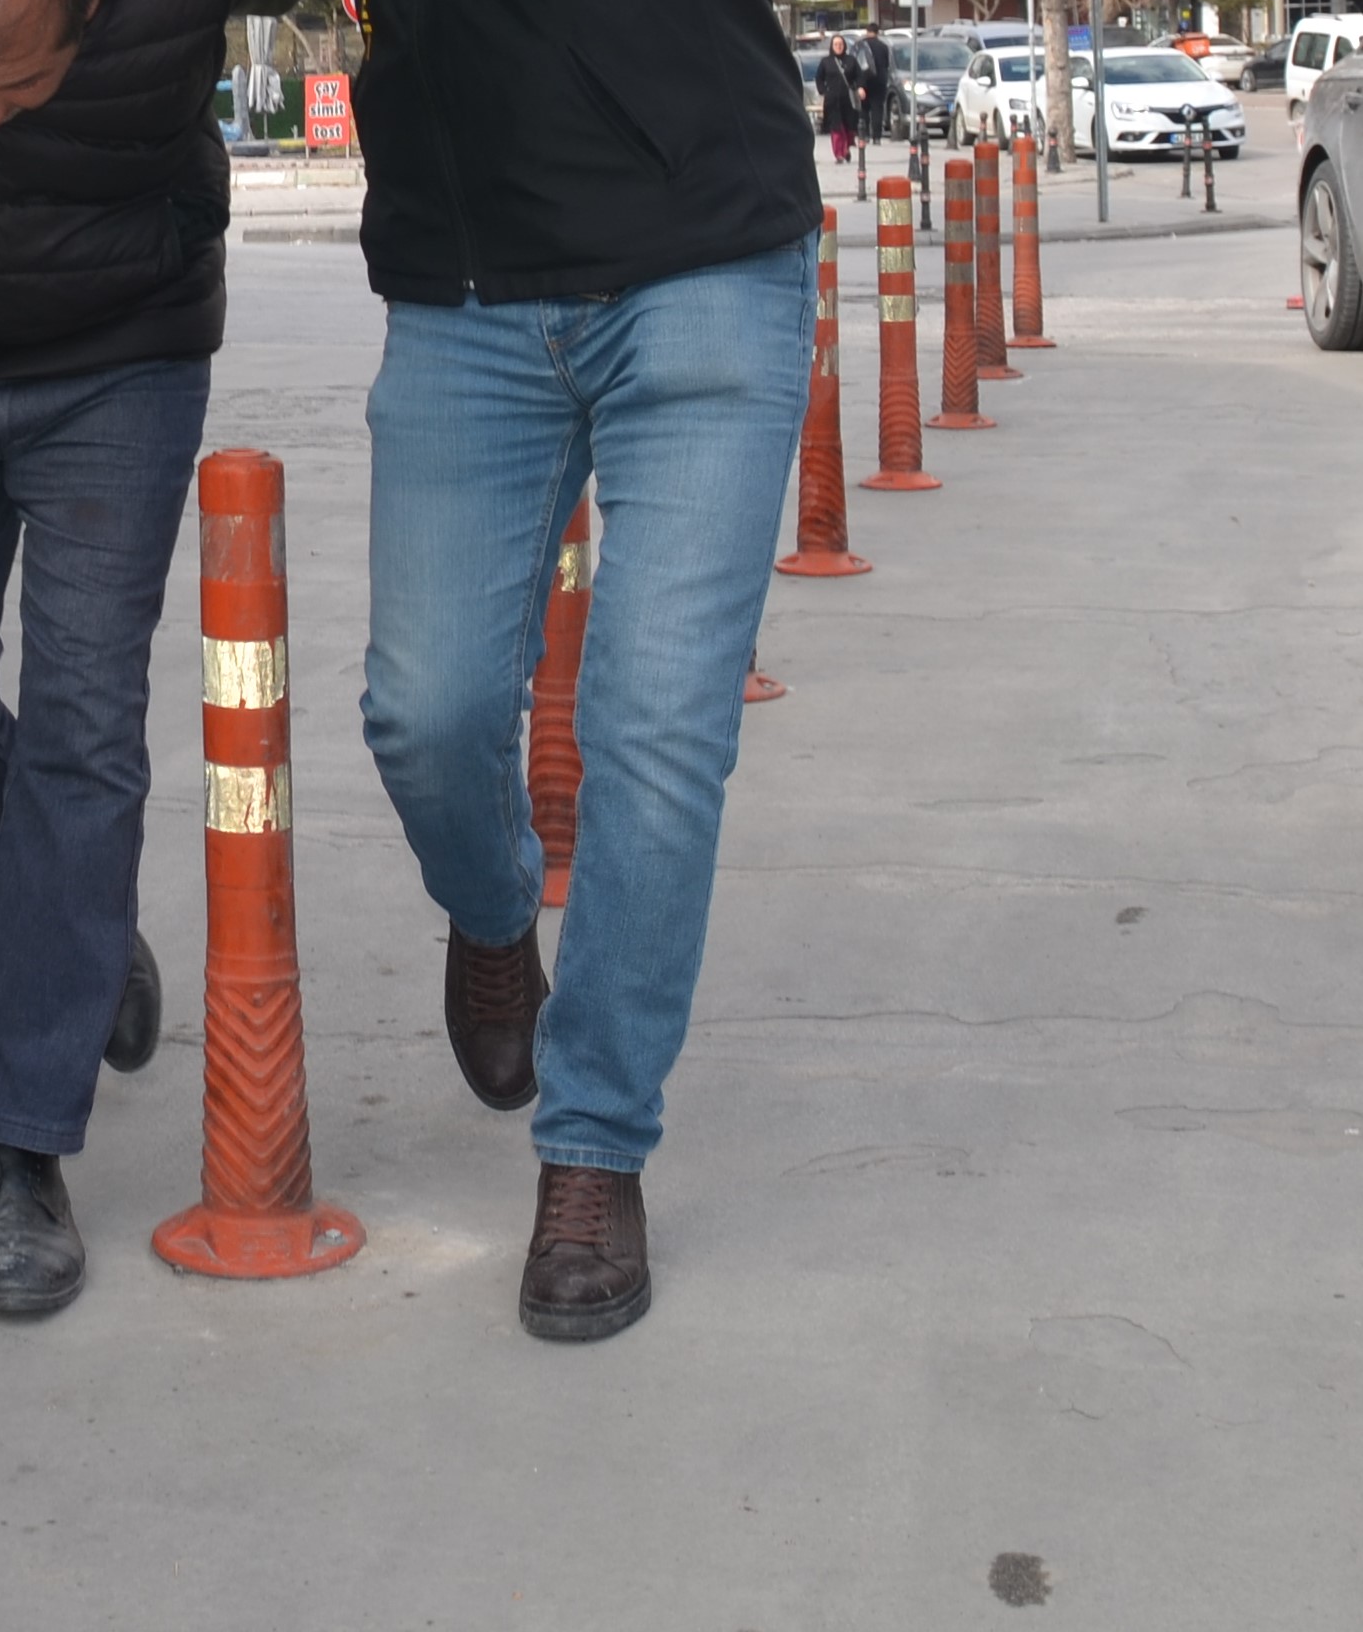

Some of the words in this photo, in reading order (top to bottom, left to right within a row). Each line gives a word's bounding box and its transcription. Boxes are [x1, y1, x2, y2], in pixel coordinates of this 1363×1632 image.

[315, 81, 339, 98] çay
[310, 99, 345, 117] simit
[314, 124, 342, 139] tost
